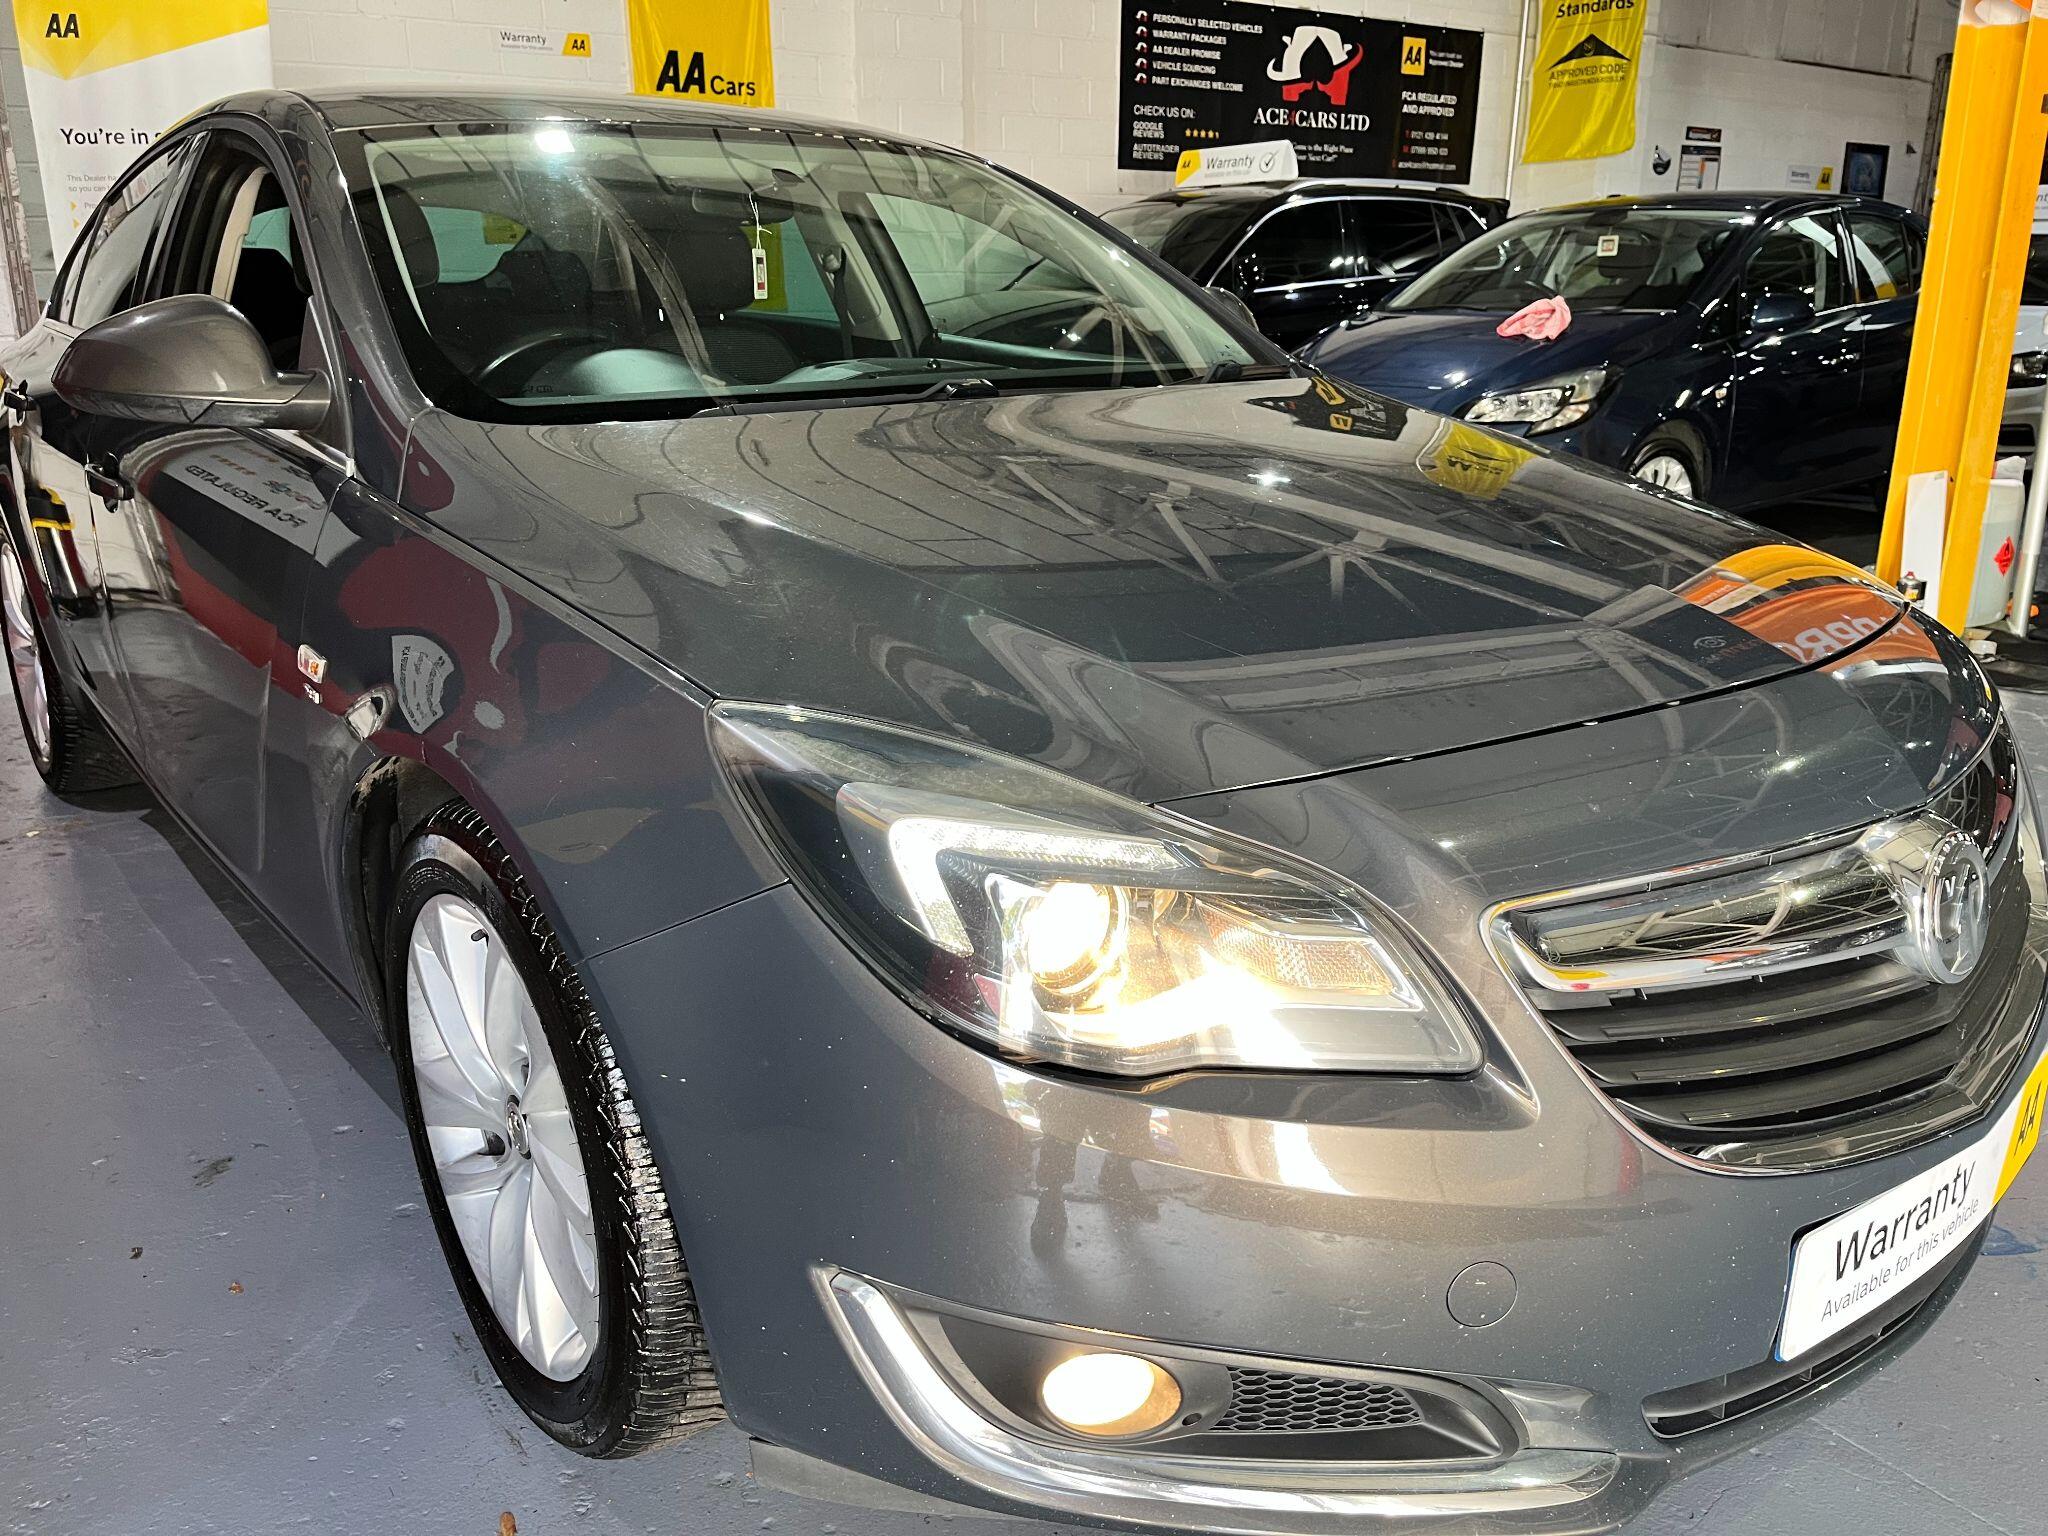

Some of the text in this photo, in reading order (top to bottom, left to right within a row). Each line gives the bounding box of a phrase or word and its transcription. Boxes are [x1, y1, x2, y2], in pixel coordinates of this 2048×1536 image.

[45, 13, 80, 39] AA
[1152, 13, 1263, 34] PERSONALLY SELECTED VEHICLES
[500, 31, 586, 51] Warranty AA
[1152, 29, 1227, 45] WARRANTY PACKAGES
[1152, 45, 1221, 60] AA DEALER PROMISE
[1404, 45, 1423, 66] AA
[655, 49, 756, 97] AA Cars
[1152, 60, 1216, 75] VEHICLE SOURCING
[1549, 65, 1598, 80] APPROVED
[1152, 75, 1244, 92] PART EXCHANGES WELCOME
[1133, 104, 1165, 117] CHECK
[1165, 107, 1180, 118] US
[1132, 121, 1164, 131] GOOGLE
[1340, 113, 1370, 131] LTD
[130, 128, 149, 145] in
[1132, 129, 1165, 139] REVIEWS
[1132, 143, 1180, 154] AUTOTRADER
[1132, 151, 1165, 161] REVIEWS
[1206, 155, 1255, 170] Warranty
[1835, 1080, 2042, 1282] Warranty AA
[1821, 1197, 1980, 1322] Available for this vehicle
